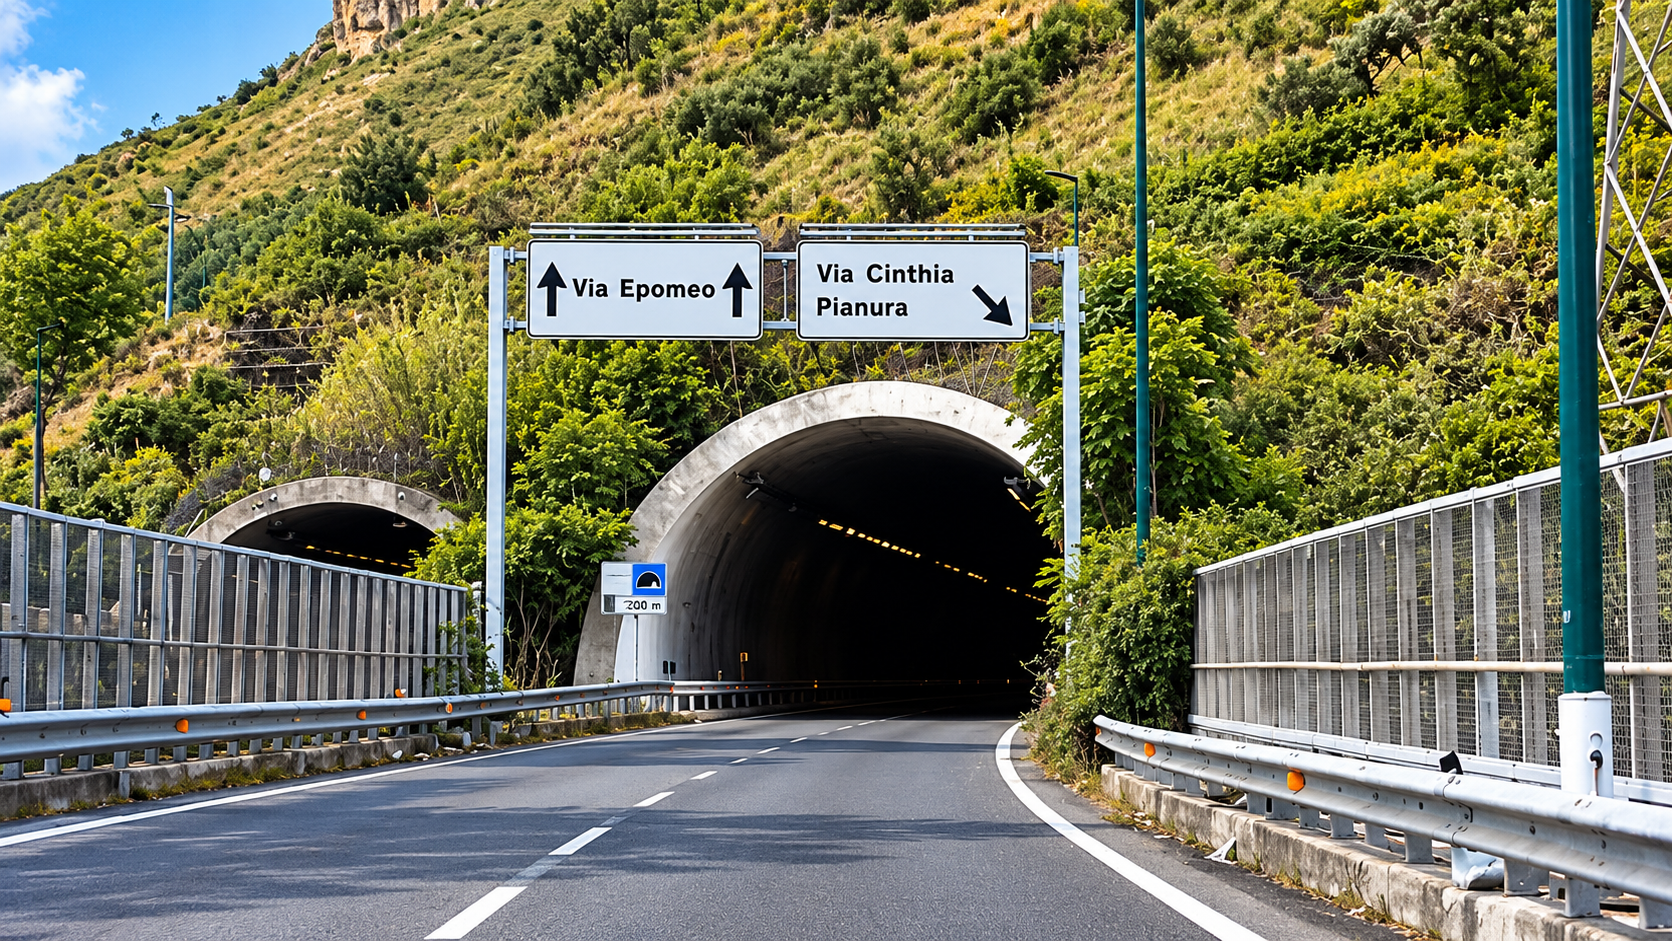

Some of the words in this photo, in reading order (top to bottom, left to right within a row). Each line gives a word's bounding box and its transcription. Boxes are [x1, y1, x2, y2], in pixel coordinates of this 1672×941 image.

[817, 263, 854, 284] Via
[866, 263, 955, 284] Cinthia
[573, 278, 609, 298] Via
[620, 278, 716, 303] Epomeo
[817, 296, 909, 317] Pianura
[652, 602, 661, 610] m
